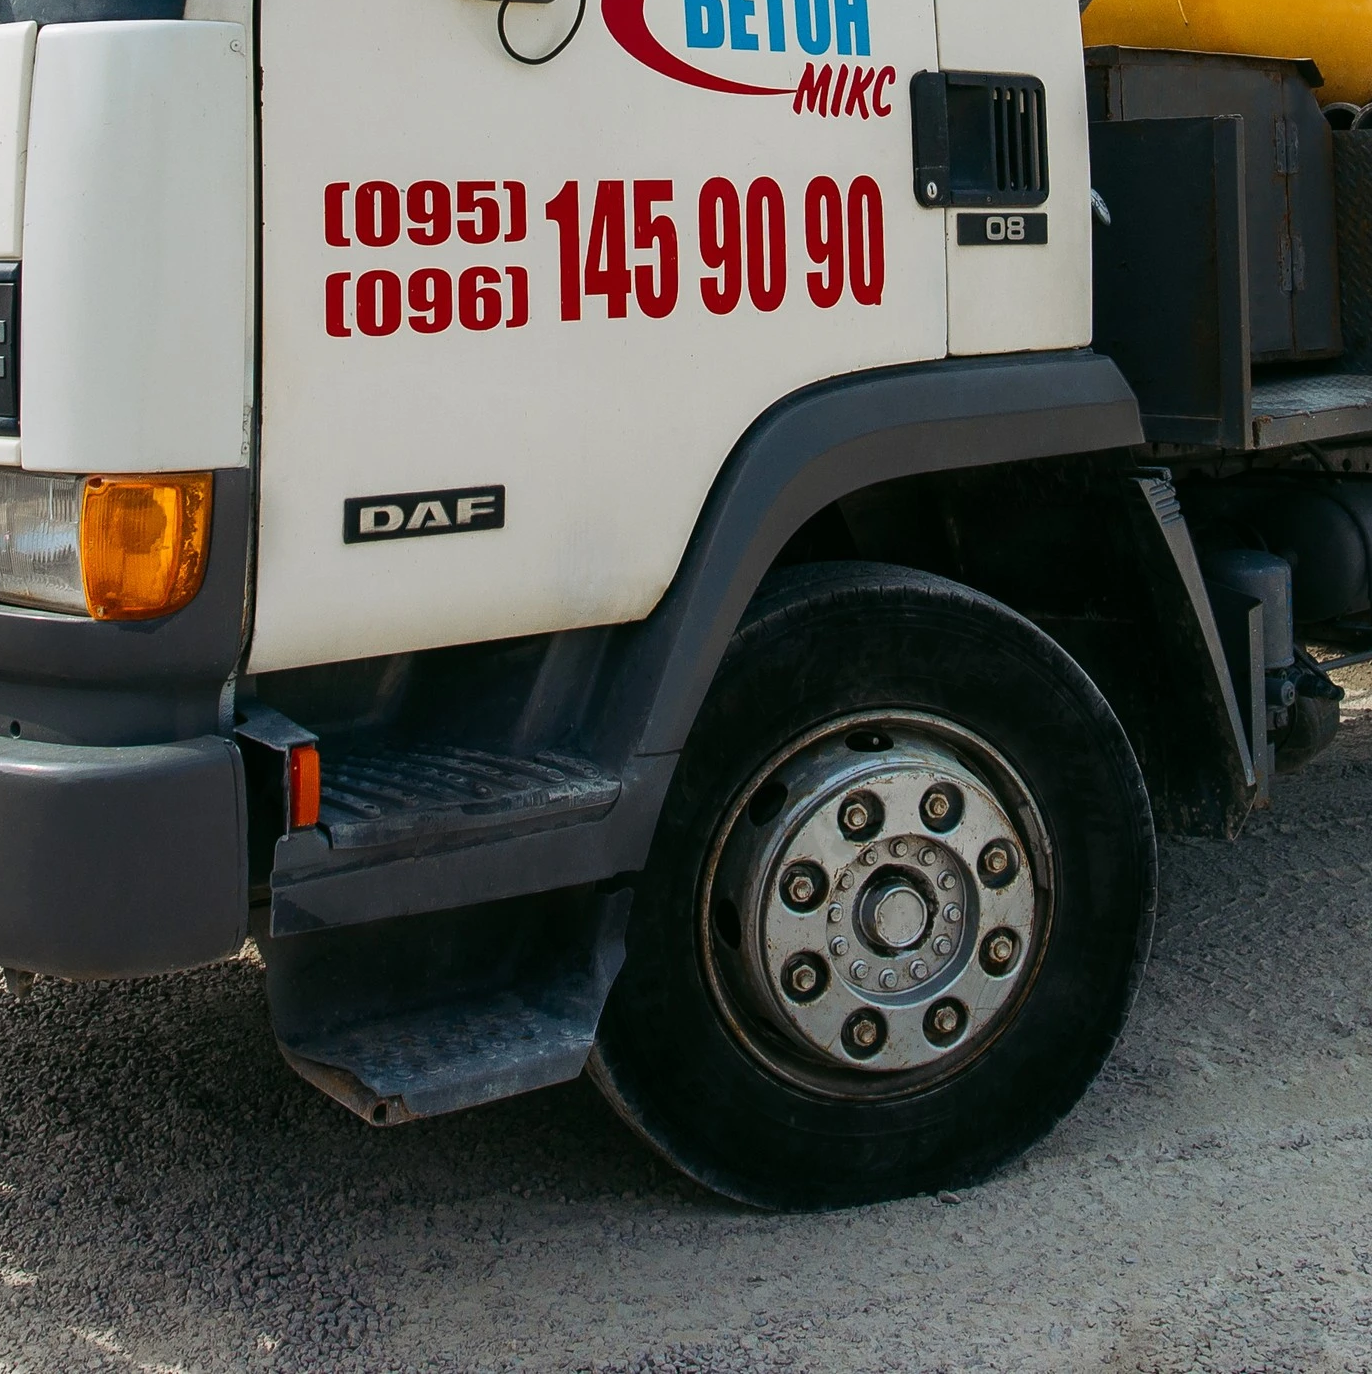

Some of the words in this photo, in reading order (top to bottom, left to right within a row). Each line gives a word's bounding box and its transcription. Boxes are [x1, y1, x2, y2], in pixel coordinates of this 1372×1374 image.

[791, 61, 895, 121] МІКС
[324, 180, 527, 247] (095)
[985, 216, 1026, 241] 08
[545, 179, 679, 321] 145
[698, 176, 786, 316] 90
[804, 174, 885, 309] 90
[325, 265, 528, 337] (096)
[359, 494, 498, 534] DAF
